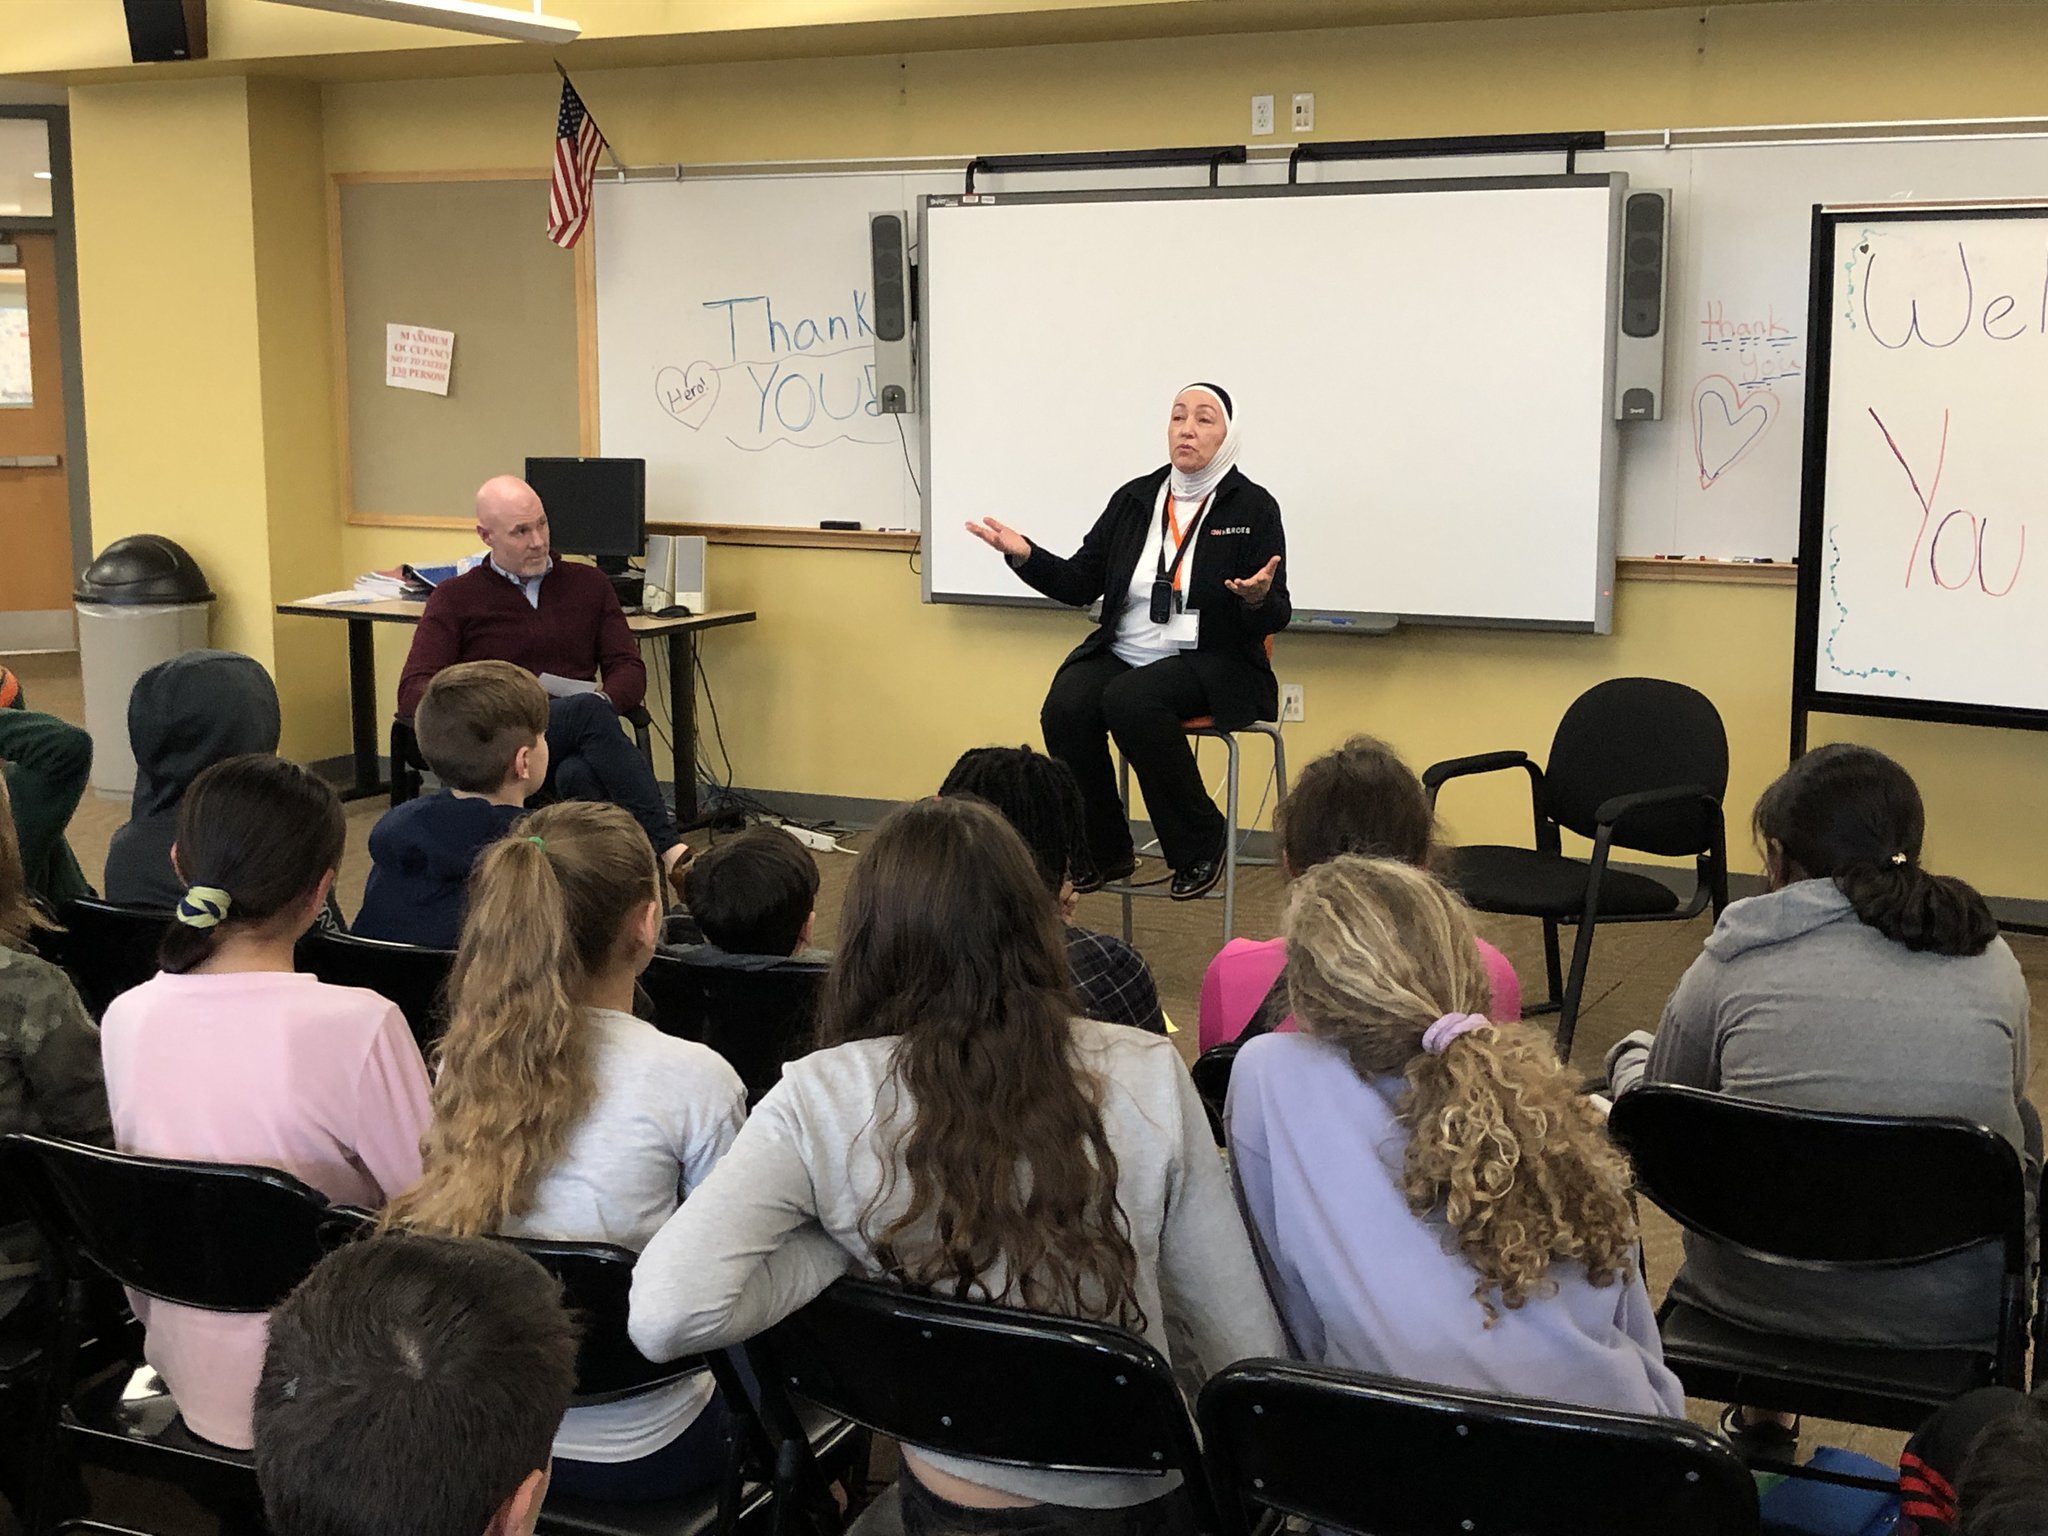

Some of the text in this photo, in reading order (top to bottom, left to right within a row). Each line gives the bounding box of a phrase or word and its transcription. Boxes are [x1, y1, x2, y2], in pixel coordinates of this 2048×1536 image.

[702, 288, 876, 362] Thank
[1700, 301, 1789, 341] thank
[1740, 351, 1800, 382] you
[666, 376, 710, 413] Hero!
[1867, 405, 2026, 597] You
